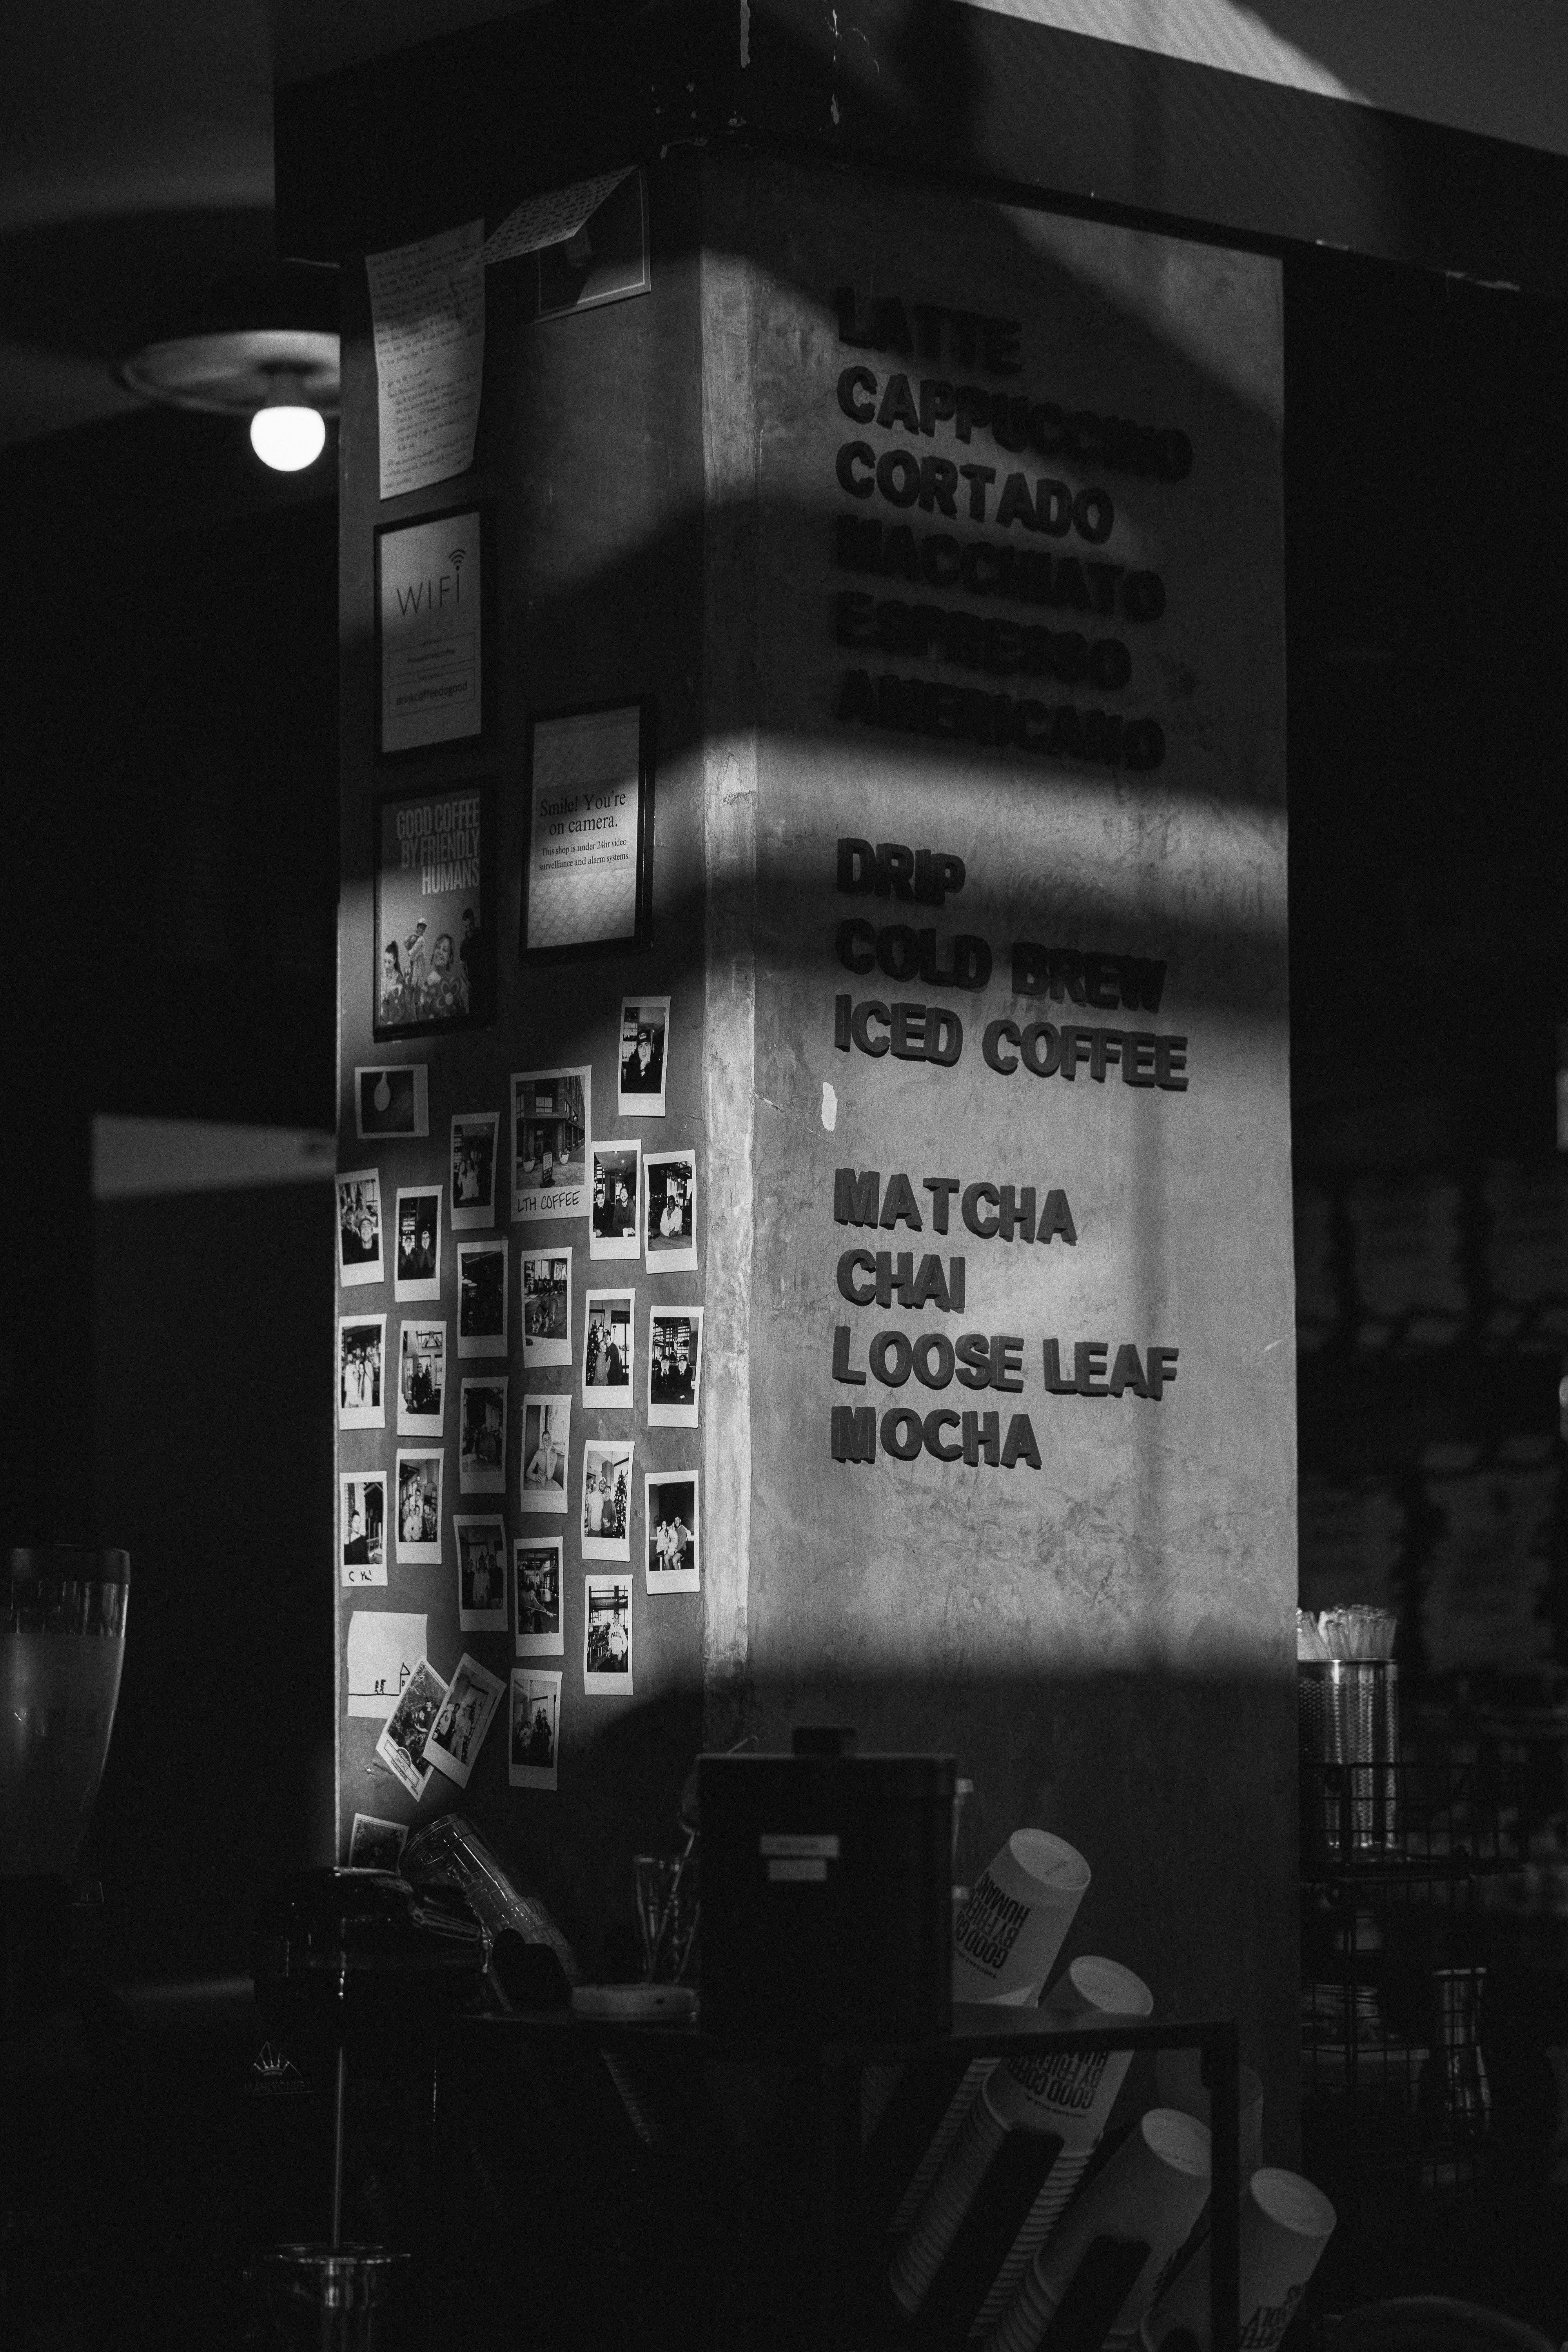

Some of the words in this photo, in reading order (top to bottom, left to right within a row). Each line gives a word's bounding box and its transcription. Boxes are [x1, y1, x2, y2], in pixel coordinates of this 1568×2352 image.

[838, 287, 1022, 374] LATTE
[837, 365, 1194, 480] CAPPUCCINO
[836, 441, 1114, 544] CORTADO
[837, 514, 1166, 622] MACCHIATO
[837, 591, 1132, 690] ESPRESSO
[396, 680, 468, 706] drinkcoffeedogood
[837, 669, 1165, 770] AMERICANO
[397, 806, 432, 840] GOOD
[434, 797, 480, 833] COFFEE
[540, 796, 578, 817] Smile!
[583, 790, 626, 811] You're
[549, 822, 564, 836] on
[568, 815, 617, 833] camera.
[401, 838, 419, 869] BY
[420, 827, 480, 866] FRIENDLY
[541, 846, 554, 856] This
[555, 846, 570, 855] shop
[571, 844, 575, 852] is
[577, 842, 596, 851] under
[597, 840, 610, 849] 24hr
[612, 838, 627, 847] video
[574, 857, 586, 866] and
[588, 855, 605, 865] alarm
[606, 853, 630, 864] systems.
[837, 838, 965, 905] DRIP
[422, 857, 480, 895] HUMANS
[837, 918, 992, 989] COLD
[1012, 942, 1167, 1013] BREW
[835, 994, 963, 1067] ICED
[982, 1020, 1188, 1091] COFFEE
[517, 1196, 537, 1212] LTH
[541, 1191, 580, 1210] COFFEE
[834, 1168, 1078, 1245] MATCHA
[837, 1249, 965, 1314] CHAI
[832, 1326, 1024, 1392] LOOSE
[1043, 1338, 1179, 1401] LEAF
[831, 1406, 1042, 1469] MOCHA
[964, 1928, 1009, 1969] GOOD
[993, 1922, 1020, 1949] BY
[1047, 2078, 1096, 2109] GOOD
[1079, 2065, 1104, 2088] BY
